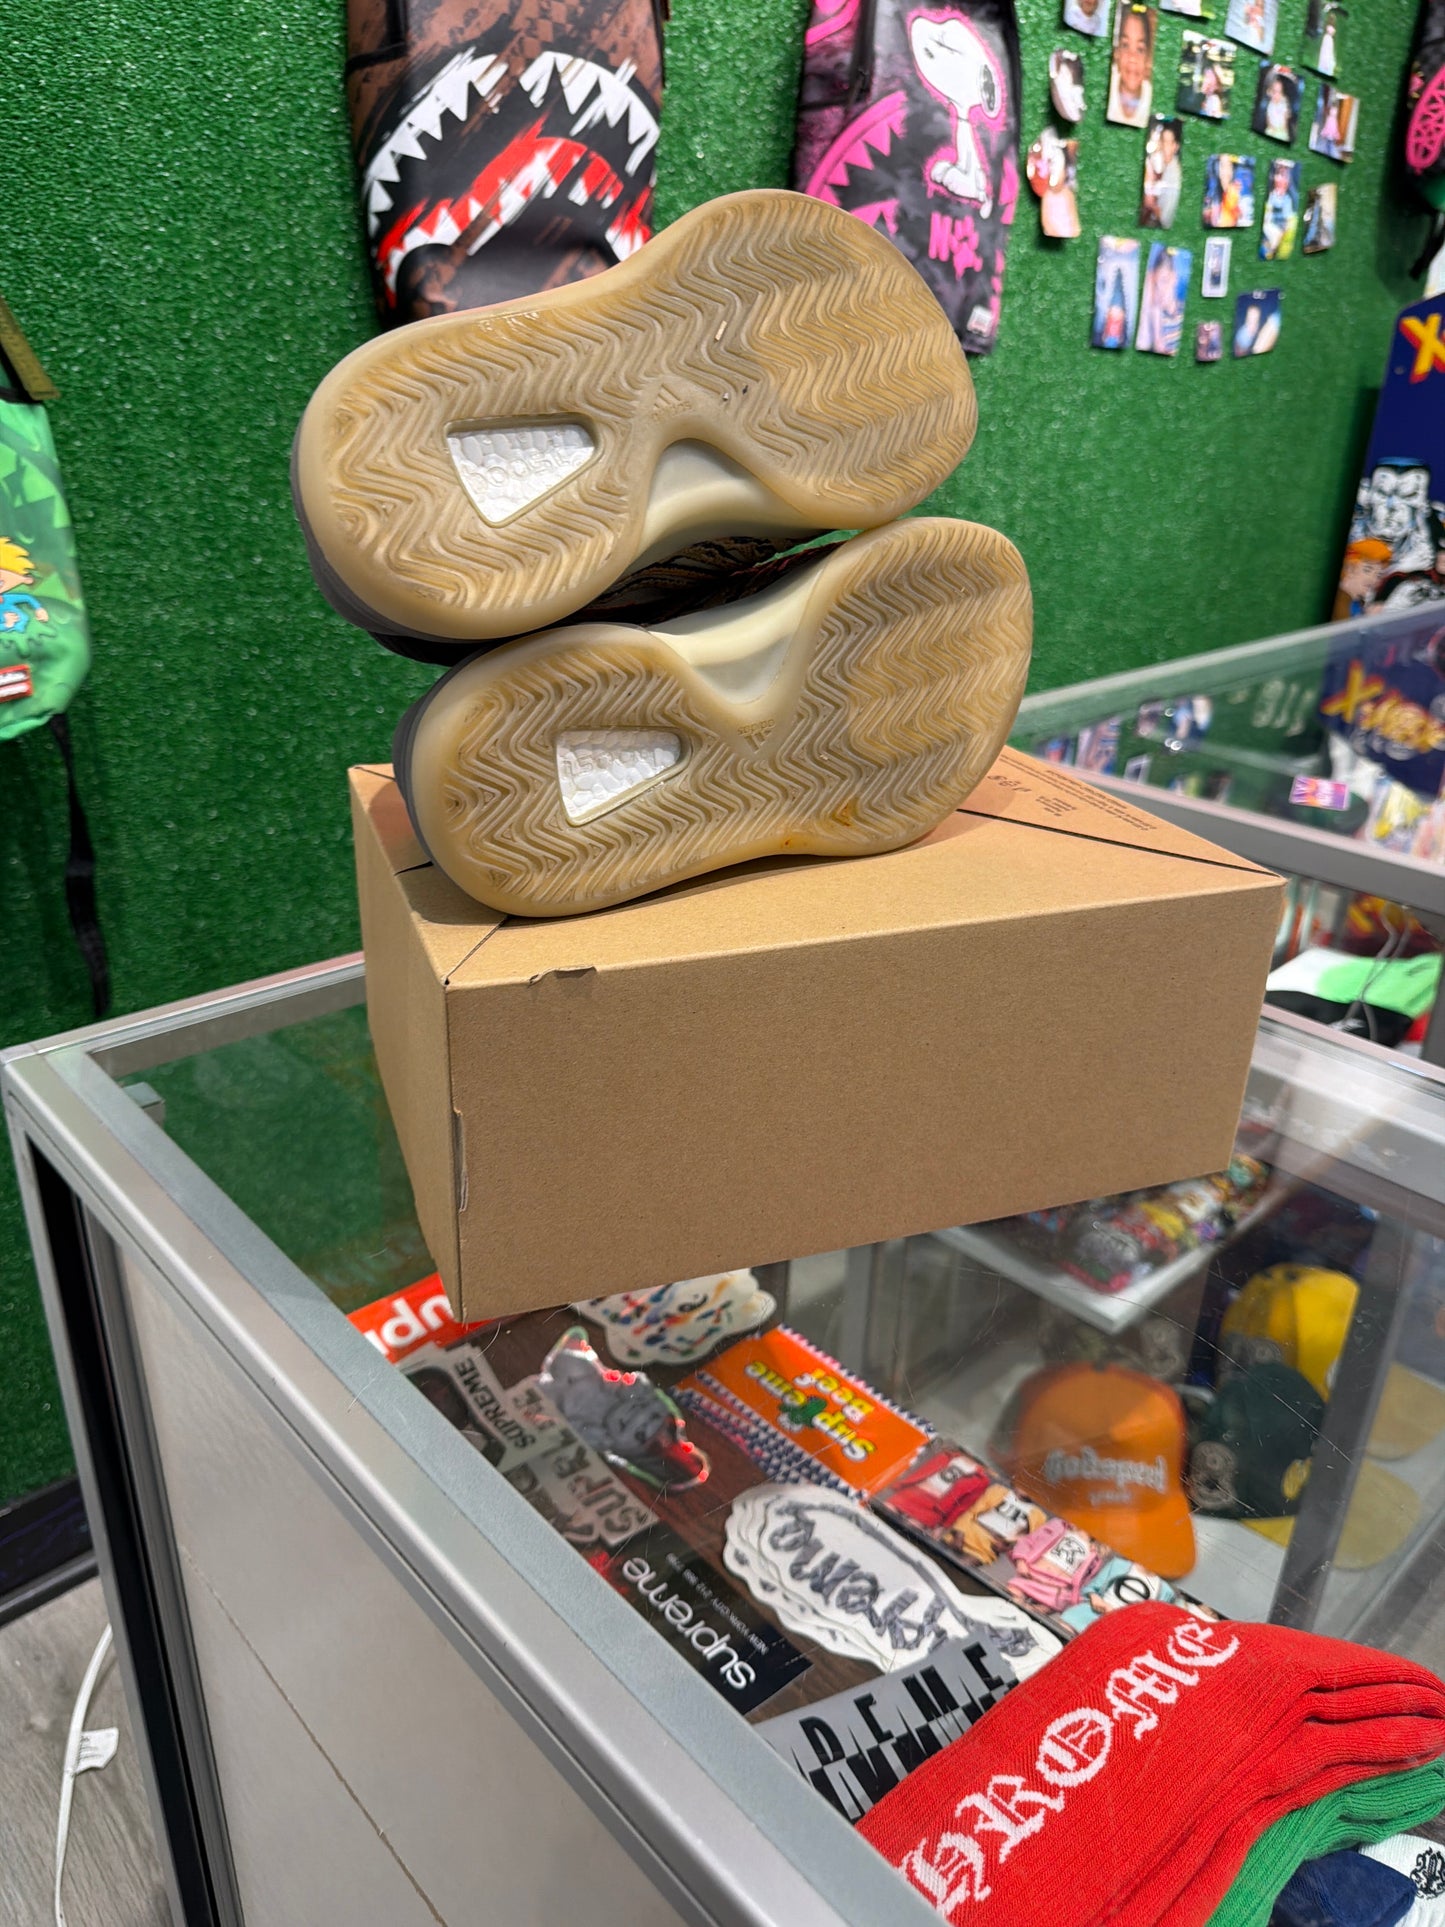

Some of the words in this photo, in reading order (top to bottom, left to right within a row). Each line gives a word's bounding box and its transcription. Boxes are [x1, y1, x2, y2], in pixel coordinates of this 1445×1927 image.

[452, 1357, 536, 1449] SUPREME
[712, 1597, 731, 1618] CITY
[622, 1557, 756, 1690] supreme
[729, 1613, 749, 1637] YORK
[748, 1632, 769, 1655] NEW
